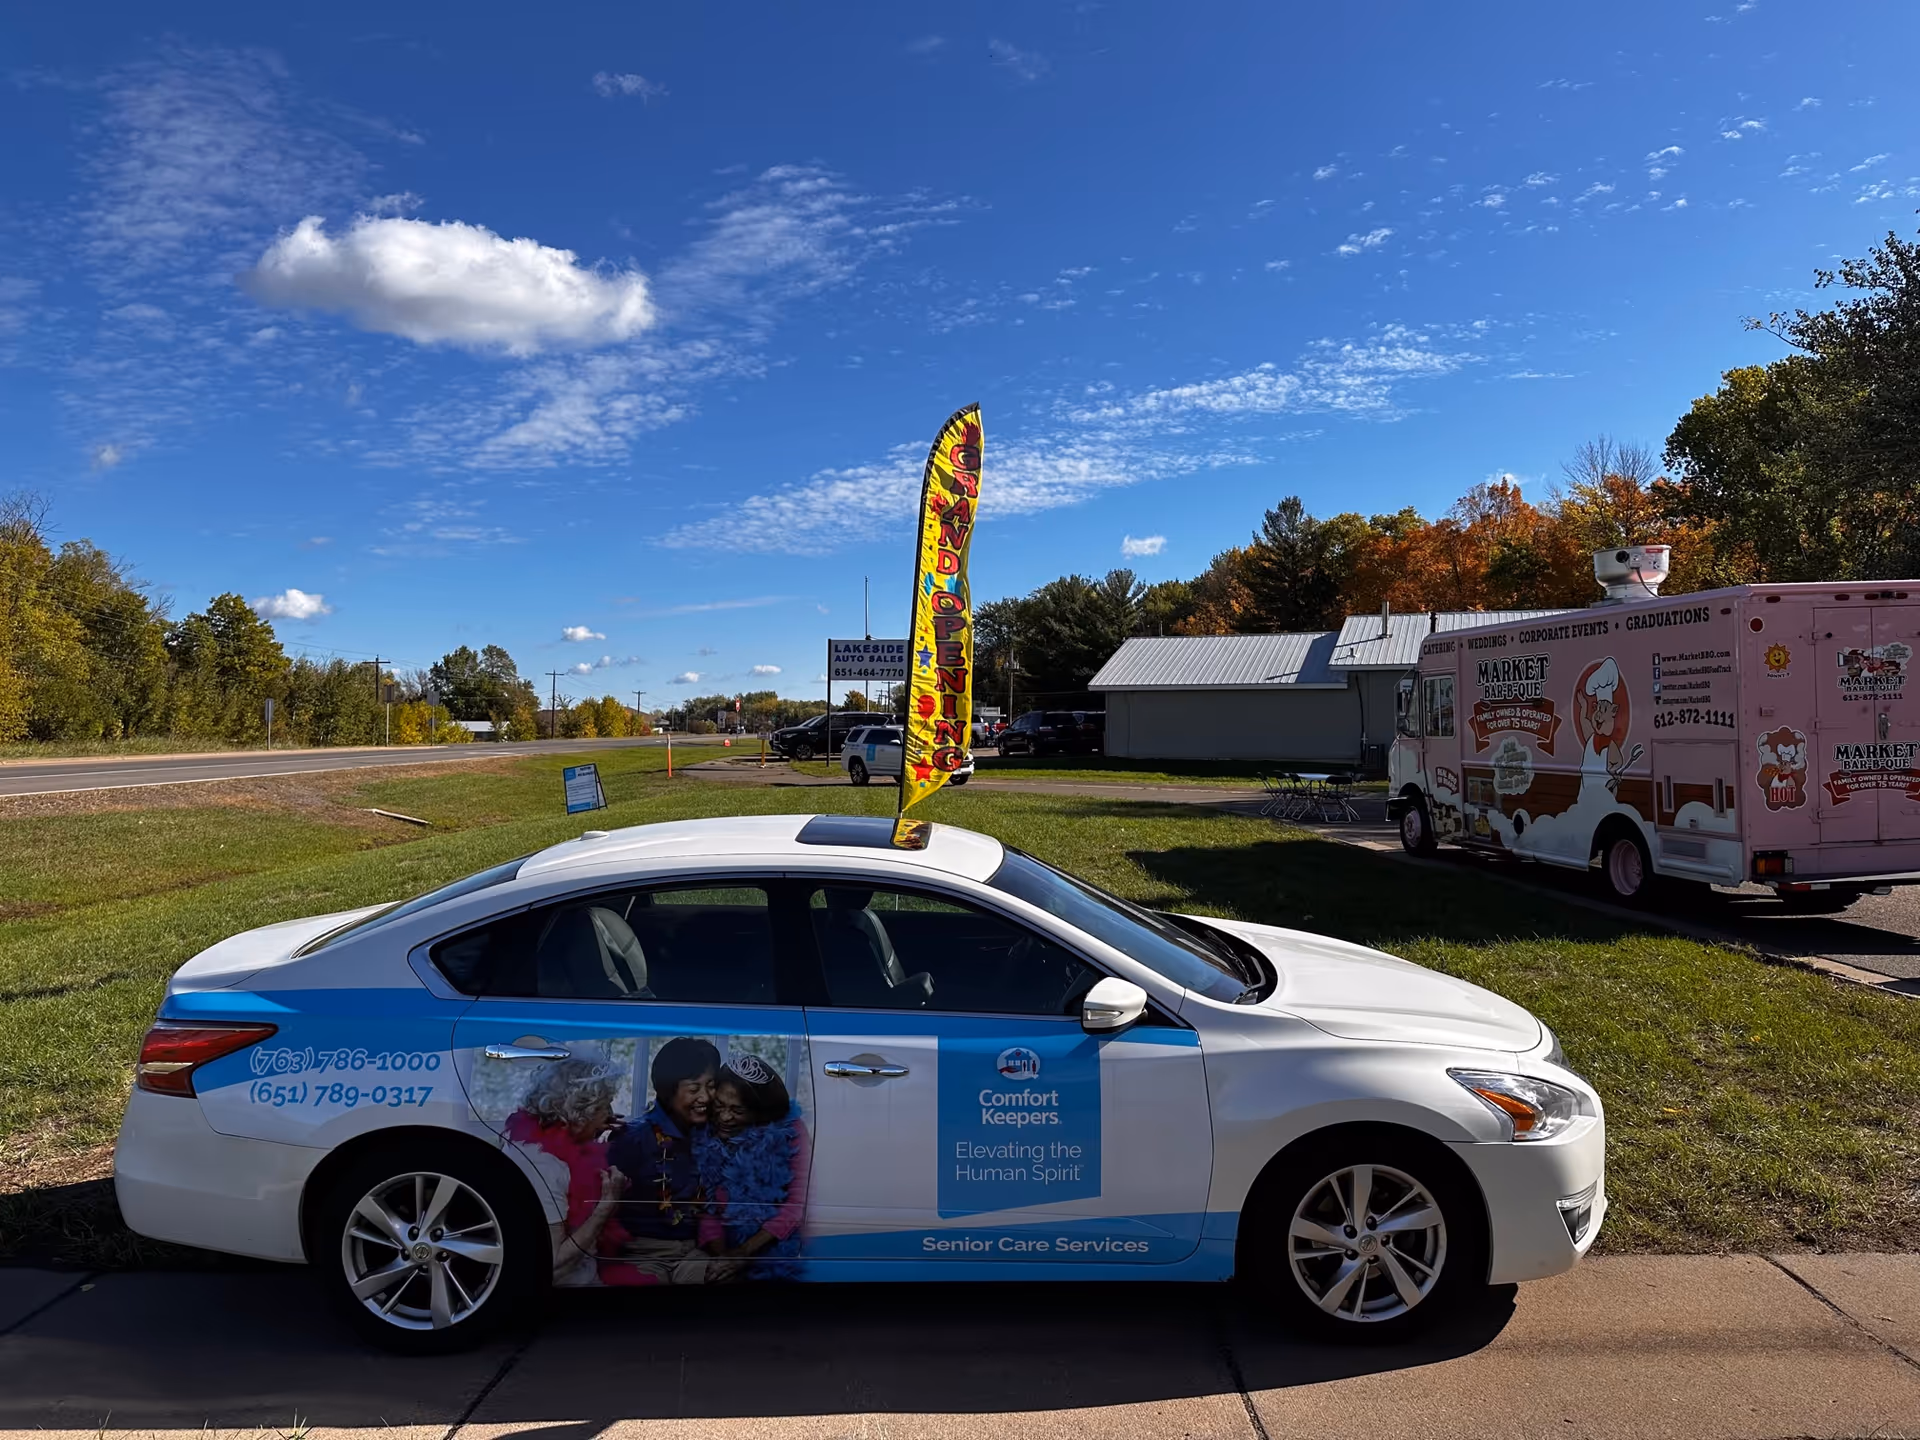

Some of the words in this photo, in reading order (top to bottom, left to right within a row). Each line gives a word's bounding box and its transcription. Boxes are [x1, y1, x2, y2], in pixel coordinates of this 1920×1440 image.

[936, 444, 981, 575] GRAND
[1423, 641, 1456, 655] CATERING
[1468, 634, 1507, 650] WEDDINGS
[1519, 625, 1570, 644] CORPORATE
[1572, 620, 1609, 638] EVENTS
[1626, 606, 1710, 631] GRADUATIONS
[834, 644, 904, 654] LAKESIDE
[834, 655, 864, 663] AUTO
[868, 655, 904, 663] SALES
[834, 668, 904, 677] 651-464-7770
[1476, 654, 1550, 686] MARKET
[932, 590, 968, 772] OPENING
[1838, 675, 1906, 687] MARKET
[1484, 682, 1542, 701] BAR-B-QUE
[1842, 693, 1904, 702] 612-872-1111
[1476, 711, 1495, 722] FAMILY
[1496, 708, 1515, 718] OWNED
[1516, 707, 1521, 717] &
[1522, 709, 1552, 722] OPERATED
[1654, 708, 1735, 729] 612-872-1111
[1486, 720, 1497, 730] FOR
[1497, 719, 1511, 729] OVER
[1511, 718, 1520, 729] 75
[1834, 742, 1919, 761] MARKET
[1843, 758, 1911, 770] BAR-B-QUE
[1833, 776, 1857, 787] FAMILY
[1858, 774, 1882, 782] OWNED
[1860, 781, 1877, 789] OVER
[1878, 780, 1888, 788] 75
[1770, 786, 1796, 803] HOT
[250, 1047, 314, 1075] (763)
[318, 1048, 441, 1074] 786-1000
[250, 1081, 308, 1108] (651)
[314, 1082, 434, 1108] 789-0317
[979, 1088, 1059, 1107] Comfort
[981, 1107, 1059, 1129] Keepers
[956, 1141, 1045, 1163] Elevating
[1050, 1141, 1082, 1159] the
[956, 1164, 1027, 1181] Human
[922, 1236, 993, 1252] Senior
[998, 1237, 1049, 1252] Care
[1055, 1236, 1149, 1253] Services
